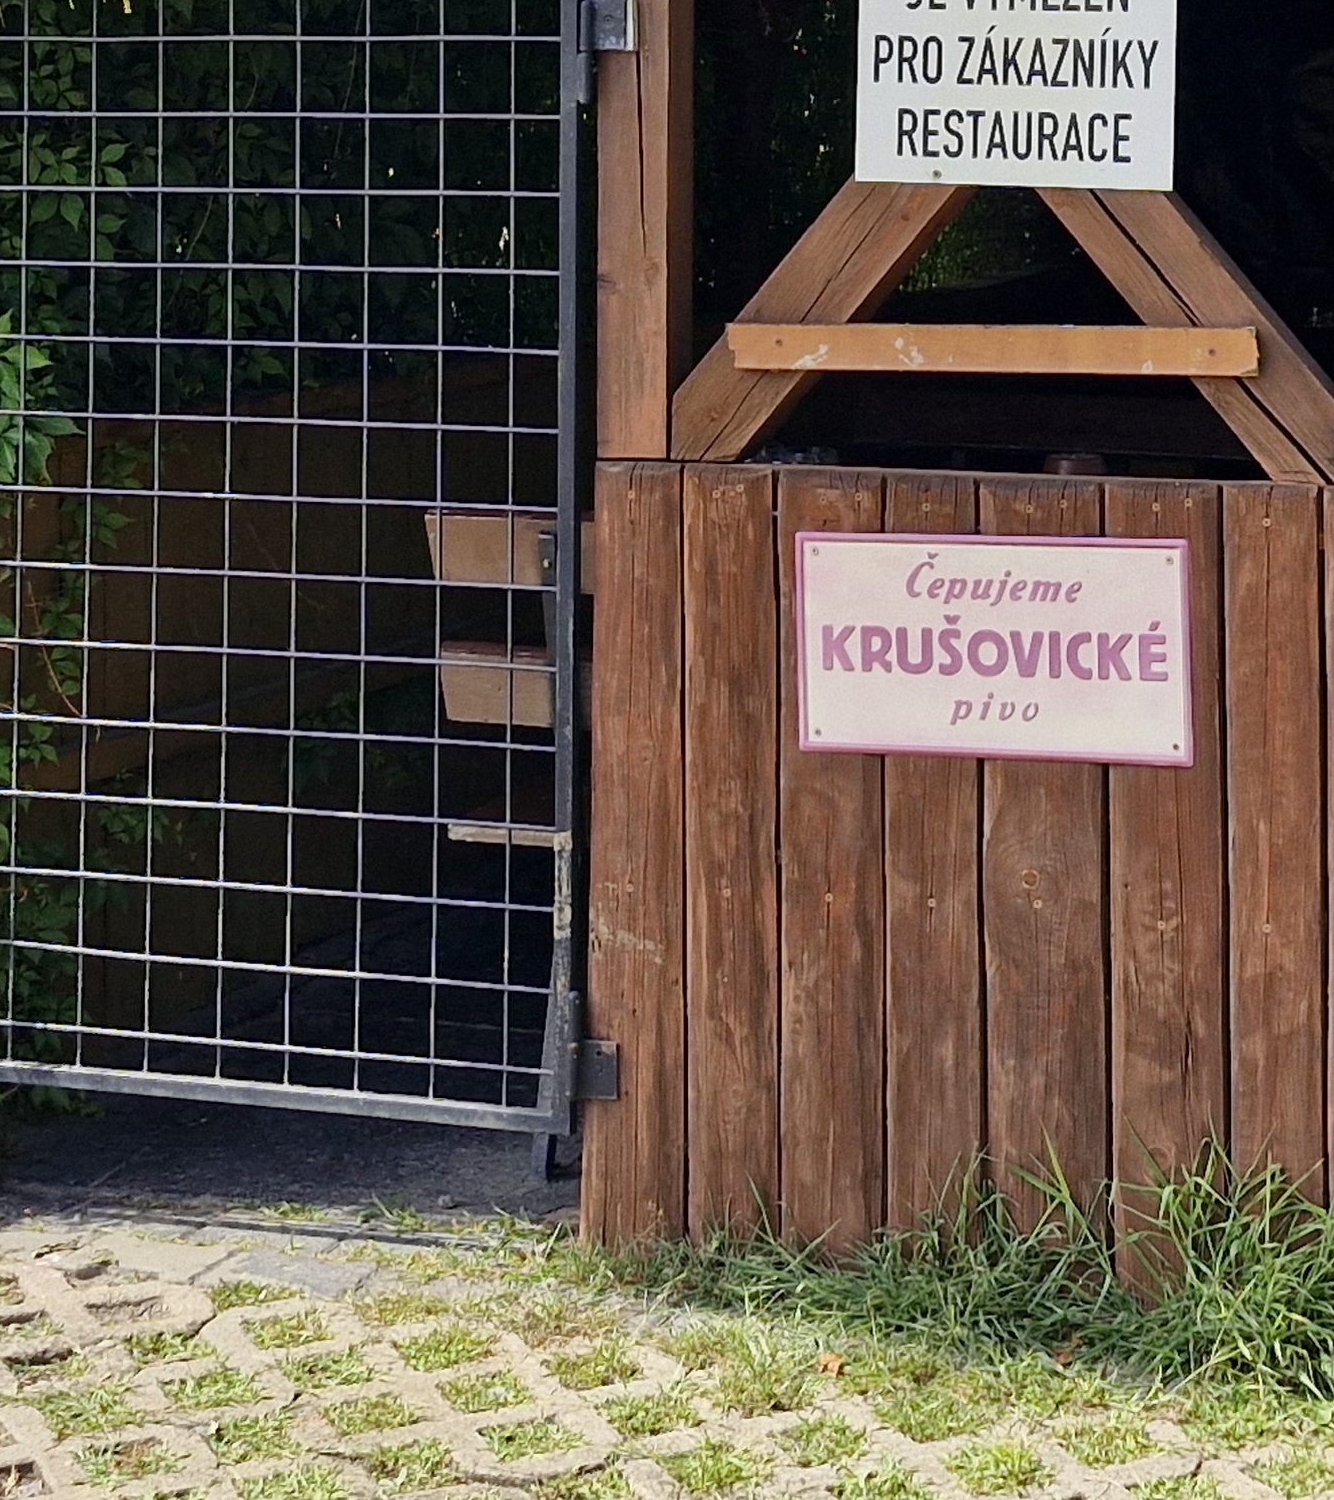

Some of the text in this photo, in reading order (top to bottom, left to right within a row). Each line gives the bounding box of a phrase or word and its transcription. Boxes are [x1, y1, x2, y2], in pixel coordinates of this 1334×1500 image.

[872, 25, 1160, 89] PRO ZÁKAZNÍKY
[896, 107, 1133, 163] RESTAURACE
[905, 551, 1084, 607] Čepujeme
[821, 614, 1169, 682] KRUŠOVICKÉ
[949, 692, 1041, 725] pivo
